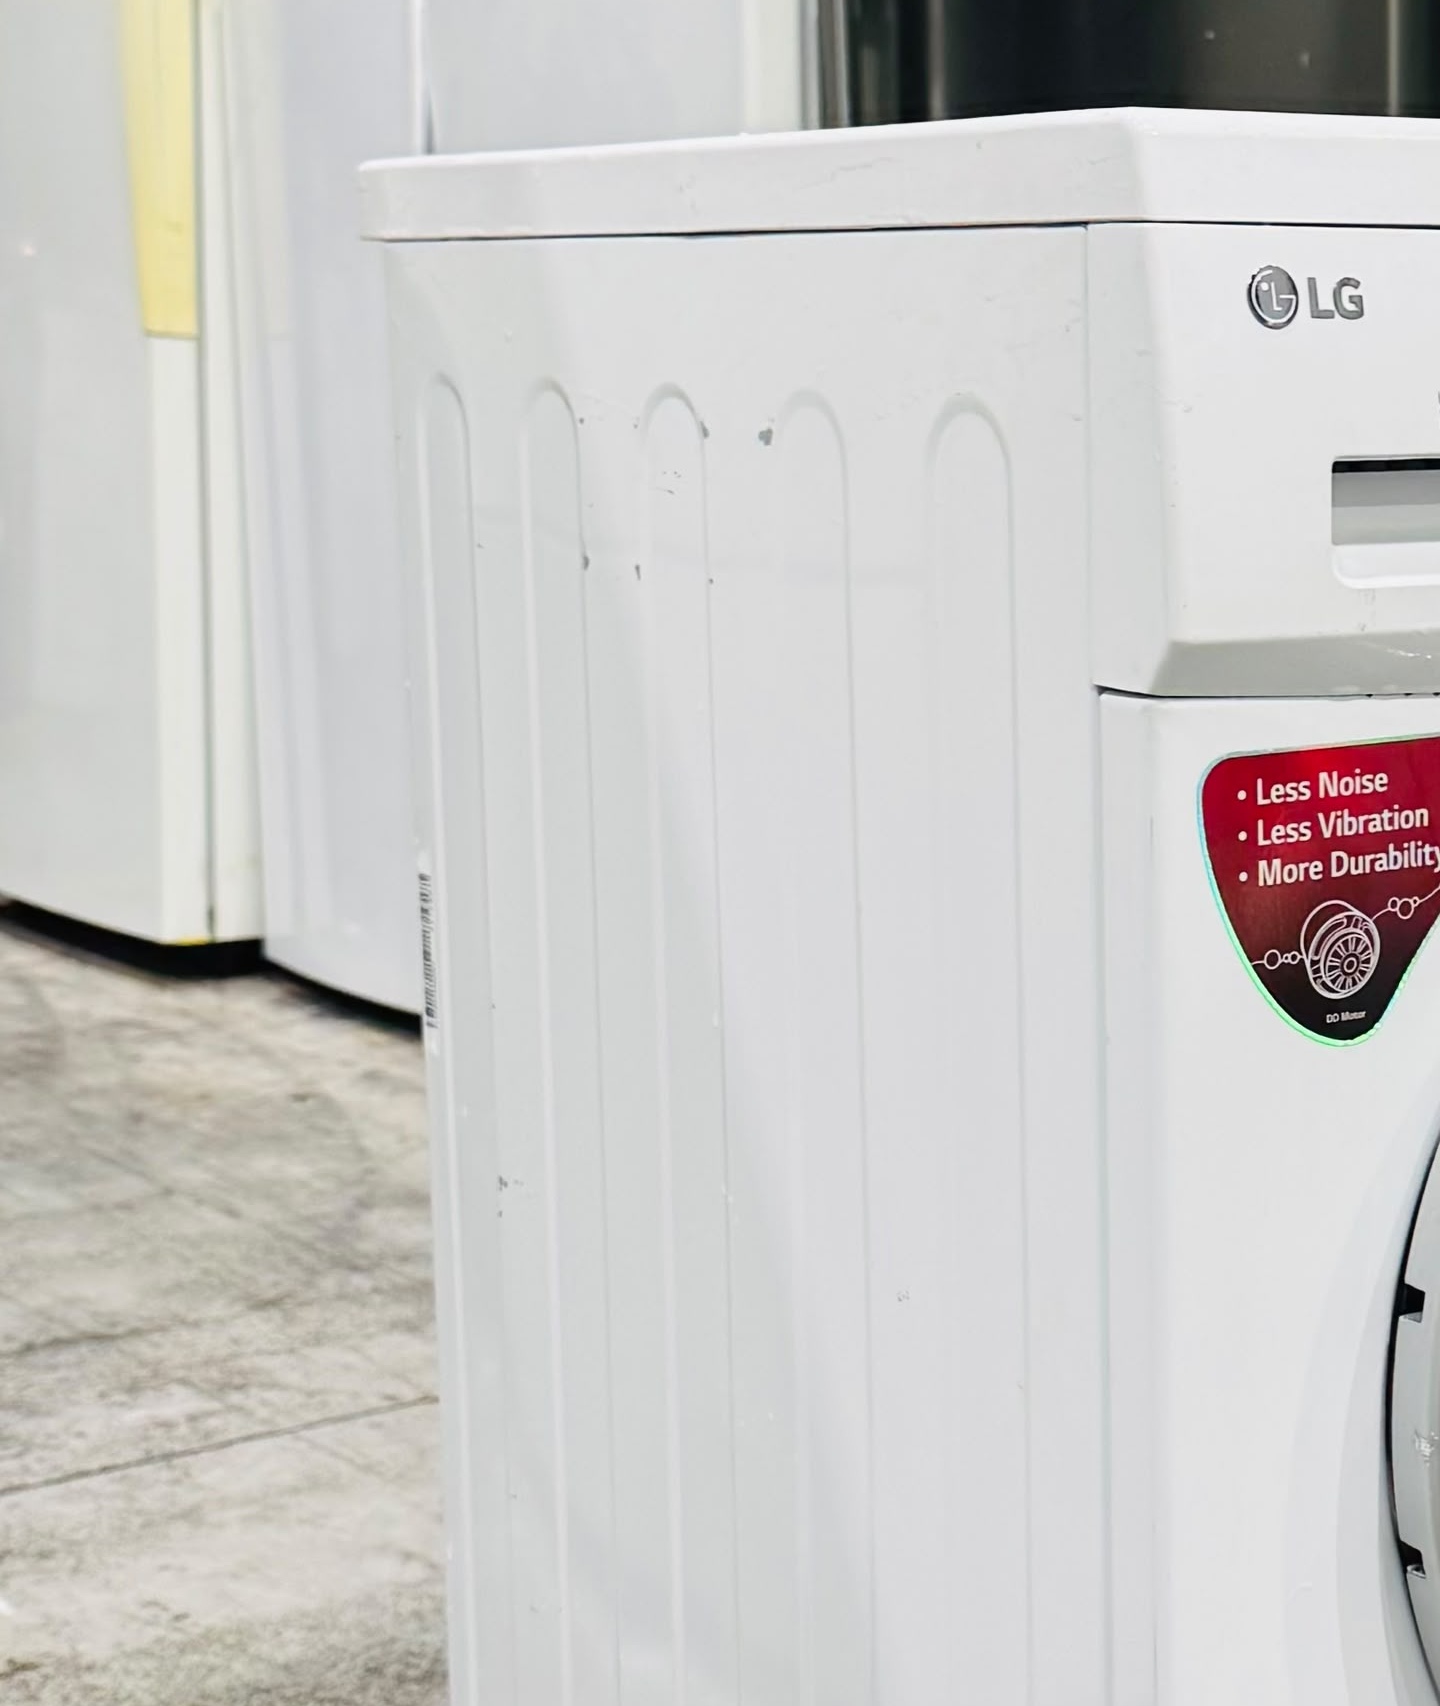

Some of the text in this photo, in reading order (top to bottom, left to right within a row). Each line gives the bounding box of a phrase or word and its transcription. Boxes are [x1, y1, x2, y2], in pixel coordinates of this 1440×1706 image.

[1306, 276, 1365, 320] LG
[1256, 769, 1389, 805] Less Noise
[1257, 804, 1429, 846] Less Vibration
[1258, 858, 1323, 886] More
[1326, 1012, 1340, 1024] DD
